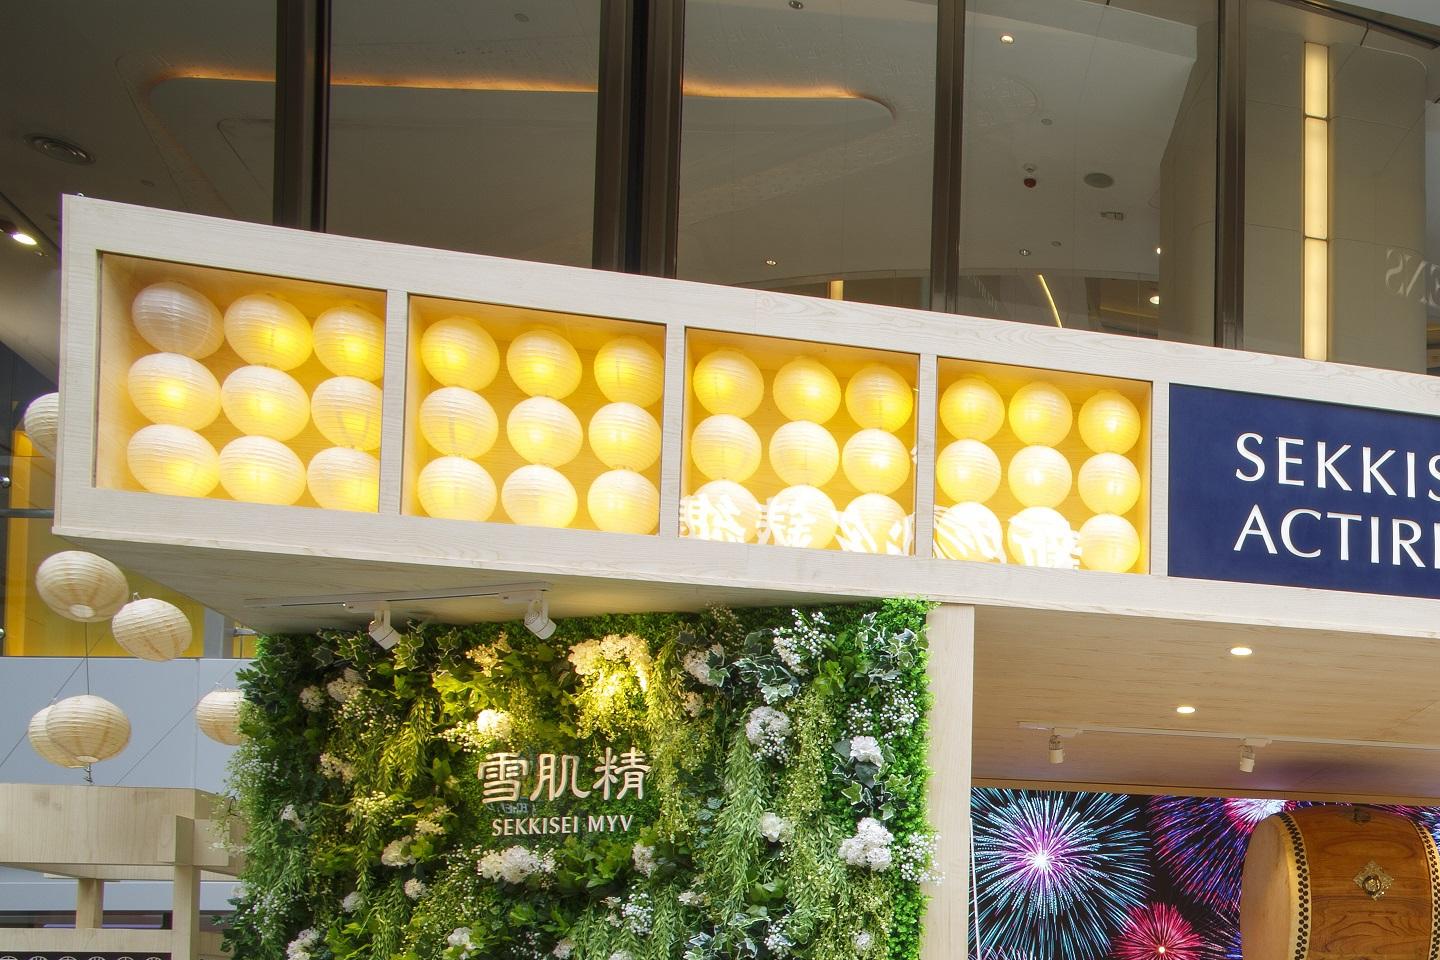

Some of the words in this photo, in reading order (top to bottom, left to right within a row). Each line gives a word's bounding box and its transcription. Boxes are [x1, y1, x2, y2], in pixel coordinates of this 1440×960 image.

[477, 746, 652, 804] 雪肌精
[491, 815, 579, 836] SEKKISEI
[588, 814, 634, 833] MYV
